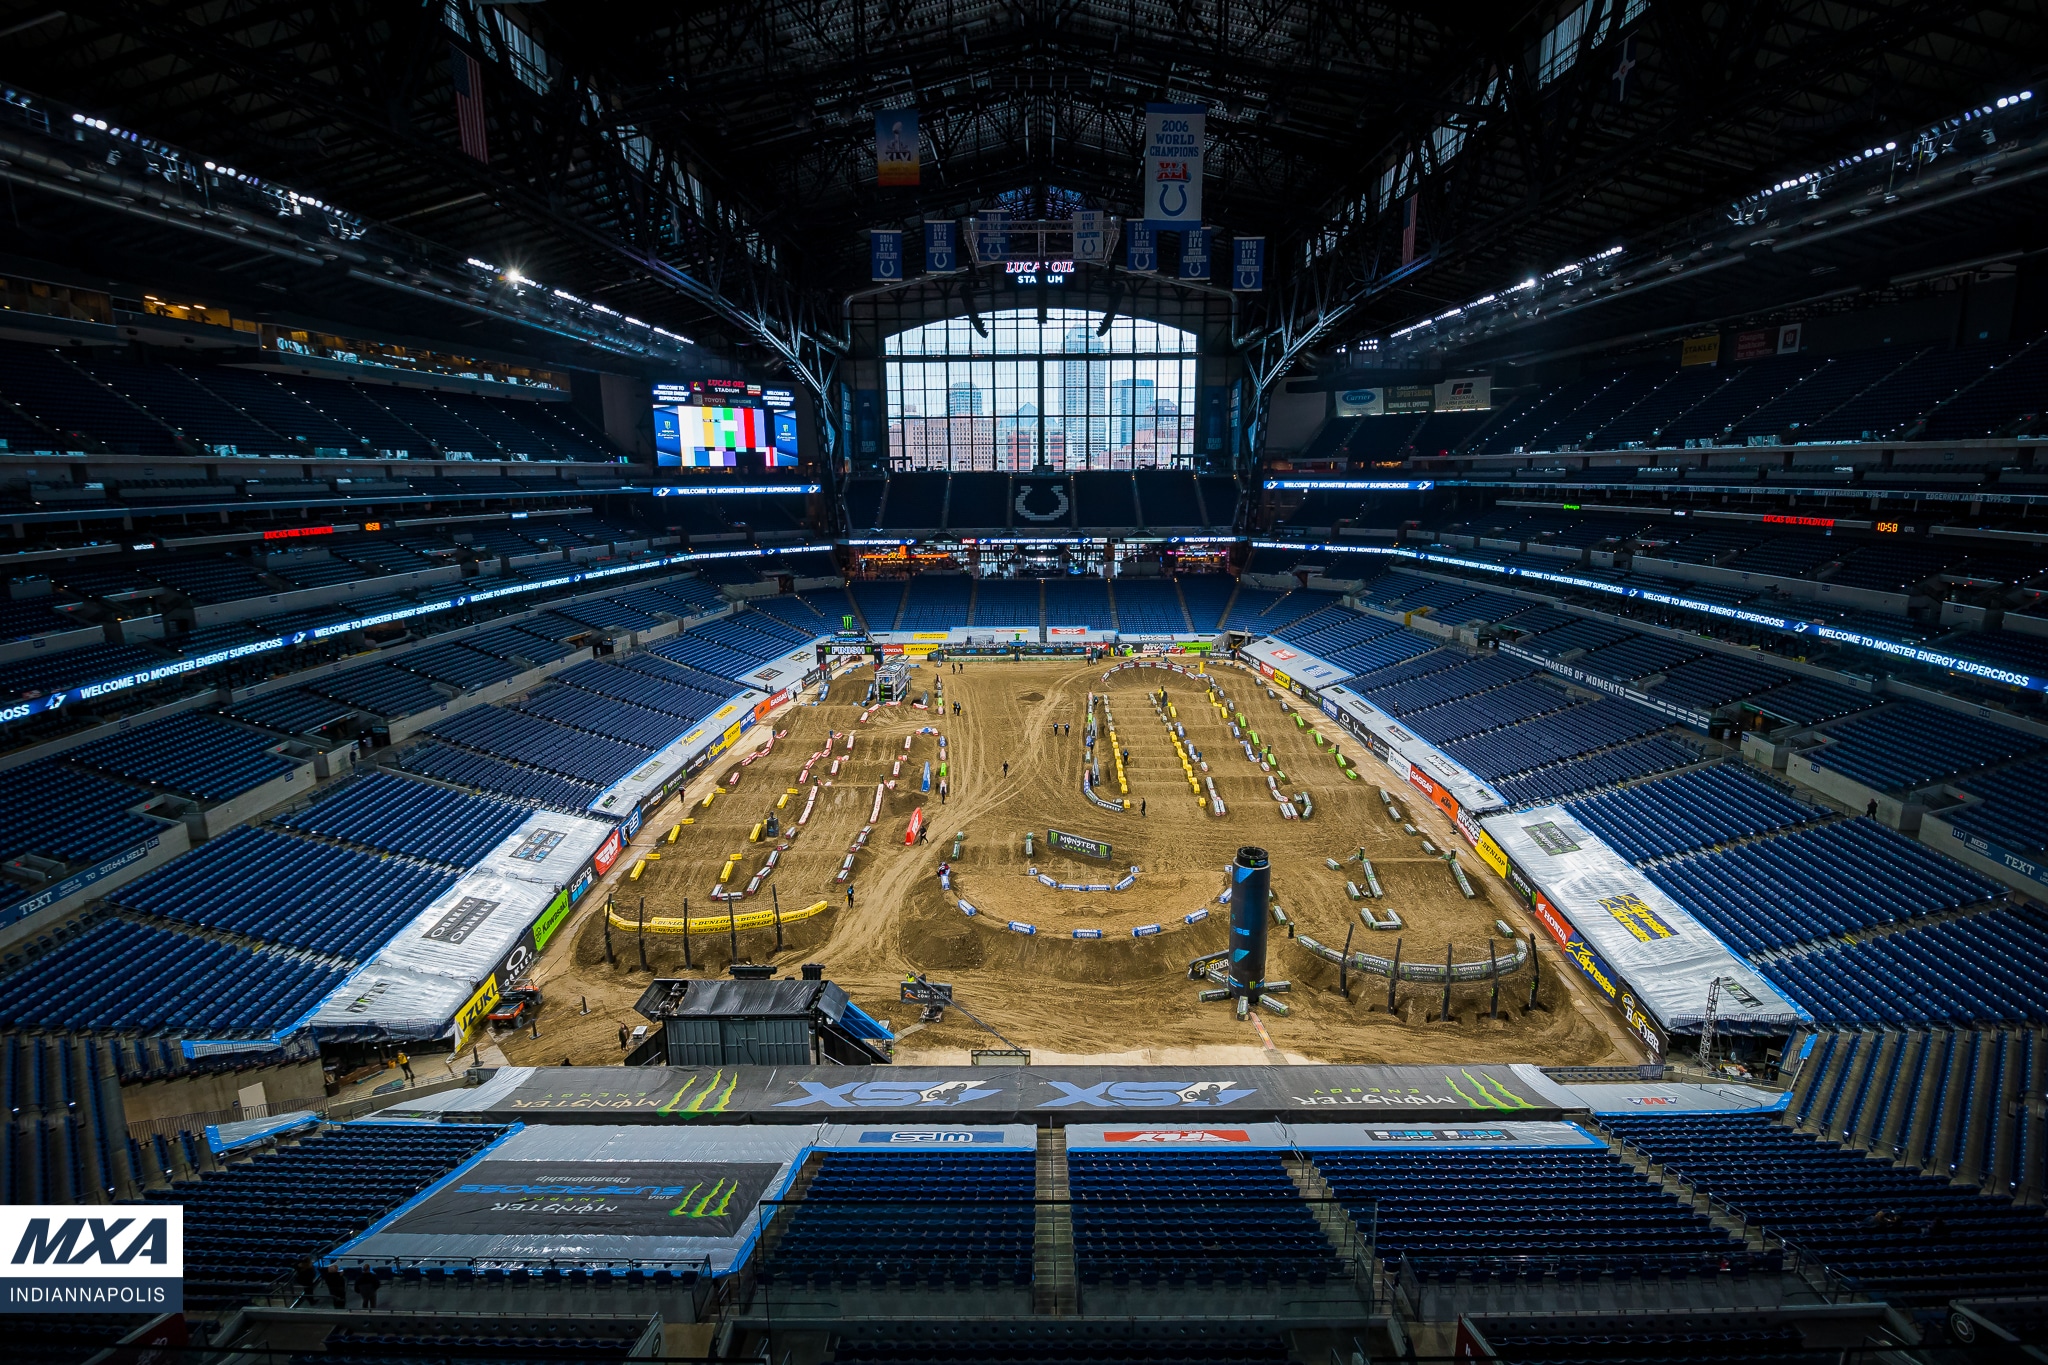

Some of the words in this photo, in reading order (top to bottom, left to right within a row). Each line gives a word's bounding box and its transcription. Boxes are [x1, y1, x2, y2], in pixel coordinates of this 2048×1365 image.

[1162, 120, 1189, 132] 2006
[1155, 133, 1195, 145] WORLD
[1150, 146, 1199, 157] CHAMPIONS
[933, 232, 947, 240] AFC
[880, 244, 893, 252] AFC
[1242, 250, 1257, 258] AFC
[1051, 261, 1075, 273] OIL
[1684, 342, 1718, 355] STANLEY
[707, 379, 732, 387] LUCAS
[732, 380, 745, 388] OIL
[1346, 393, 1372, 401] Carrier
[1925, 493, 1960, 501] EDGERRIN
[1960, 494, 1984, 502] JAMES
[1762, 514, 1784, 524] LUCAS
[1785, 515, 1797, 525] OIL
[1798, 516, 1835, 528] STADIUM
[1877, 522, 1899, 533] 10:58
[263, 530, 288, 540] LUCAS
[1521, 570, 1543, 579] WELCOME
[1543, 572, 1550, 580] TO
[1550, 574, 1573, 584] MONSTER
[1573, 577, 1593, 588] ENERGY
[1593, 581, 1623, 593] SUPERCROSS
[471, 591, 494, 603] WELCOME
[501, 585, 523, 597] MONSTER
[523, 582, 541, 591] ENERGY
[541, 576, 570, 588] SUPERCROSS
[1643, 592, 1671, 604] WELCOME
[1671, 597, 1679, 605] TO
[1680, 599, 1709, 612] MONSTER
[1710, 605, 1737, 617] ENERGY
[1737, 611, 1785, 628] SUPERCROSS
[314, 622, 350, 638] WELCOME
[351, 620, 360, 630] TO
[361, 613, 393, 627] MONSTER
[393, 608, 416, 621] ENERGY
[416, 601, 452, 616] SUPERCROSS
[831, 645, 866, 655] FINISH
[1818, 628, 1861, 645] WELCOME
[1861, 636, 1874, 647] TO
[1874, 640, 1917, 658] MONSTER
[1917, 650, 1957, 668] ENERGY
[1957, 660, 2029, 687] SUPERCROSS
[80, 676, 133, 699] WELCOME
[135, 672, 149, 684] TO
[150, 660, 195, 680] MONSTER
[195, 650, 230, 668] ENERGY
[229, 638, 283, 658] SUPERCROSS
[1544, 659, 1572, 677] MAKERS
[1574, 670, 1583, 681] OF
[1585, 675, 1625, 697] MOMENTS
[770, 692, 788, 706] GASGAS
[1410, 770, 1433, 794] GASGAS
[1440, 796, 1452, 810] KTM
[1953, 829, 1965, 839] 117
[595, 833, 619, 863] FLY
[1060, 835, 1096, 851] MONSTER
[1065, 844, 1091, 854] ENERGY
[1482, 841, 1506, 867] DUNLOP
[2004, 853, 2035, 876] TEXT
[571, 867, 592, 893] GoPro
[1511, 870, 1531, 897] MONSTER
[19, 891, 52, 916] TEXT
[85, 872, 96, 881] TO
[442, 898, 475, 927] OAKLEY
[463, 902, 493, 931] OAKLEY
[542, 897, 568, 934] Kawasaki
[740, 912, 773, 922] DUNLOP
[782, 913, 808, 922] DUNLOP
[741, 920, 772, 928] DUNLOP
[1544, 909, 1567, 945] HONDA
[1363, 955, 1389, 968] MONSTER
[504, 951, 533, 987] OAKLEY
[1579, 954, 1617, 999] alpinestars
[511, 1098, 662, 1109] MONSTER
[1291, 1094, 1458, 1106] MONSTER
[535, 1176, 631, 1184] Championship
[453, 1184, 685, 1196] SUPERCROSS
[490, 1202, 618, 1213] MONSTER
